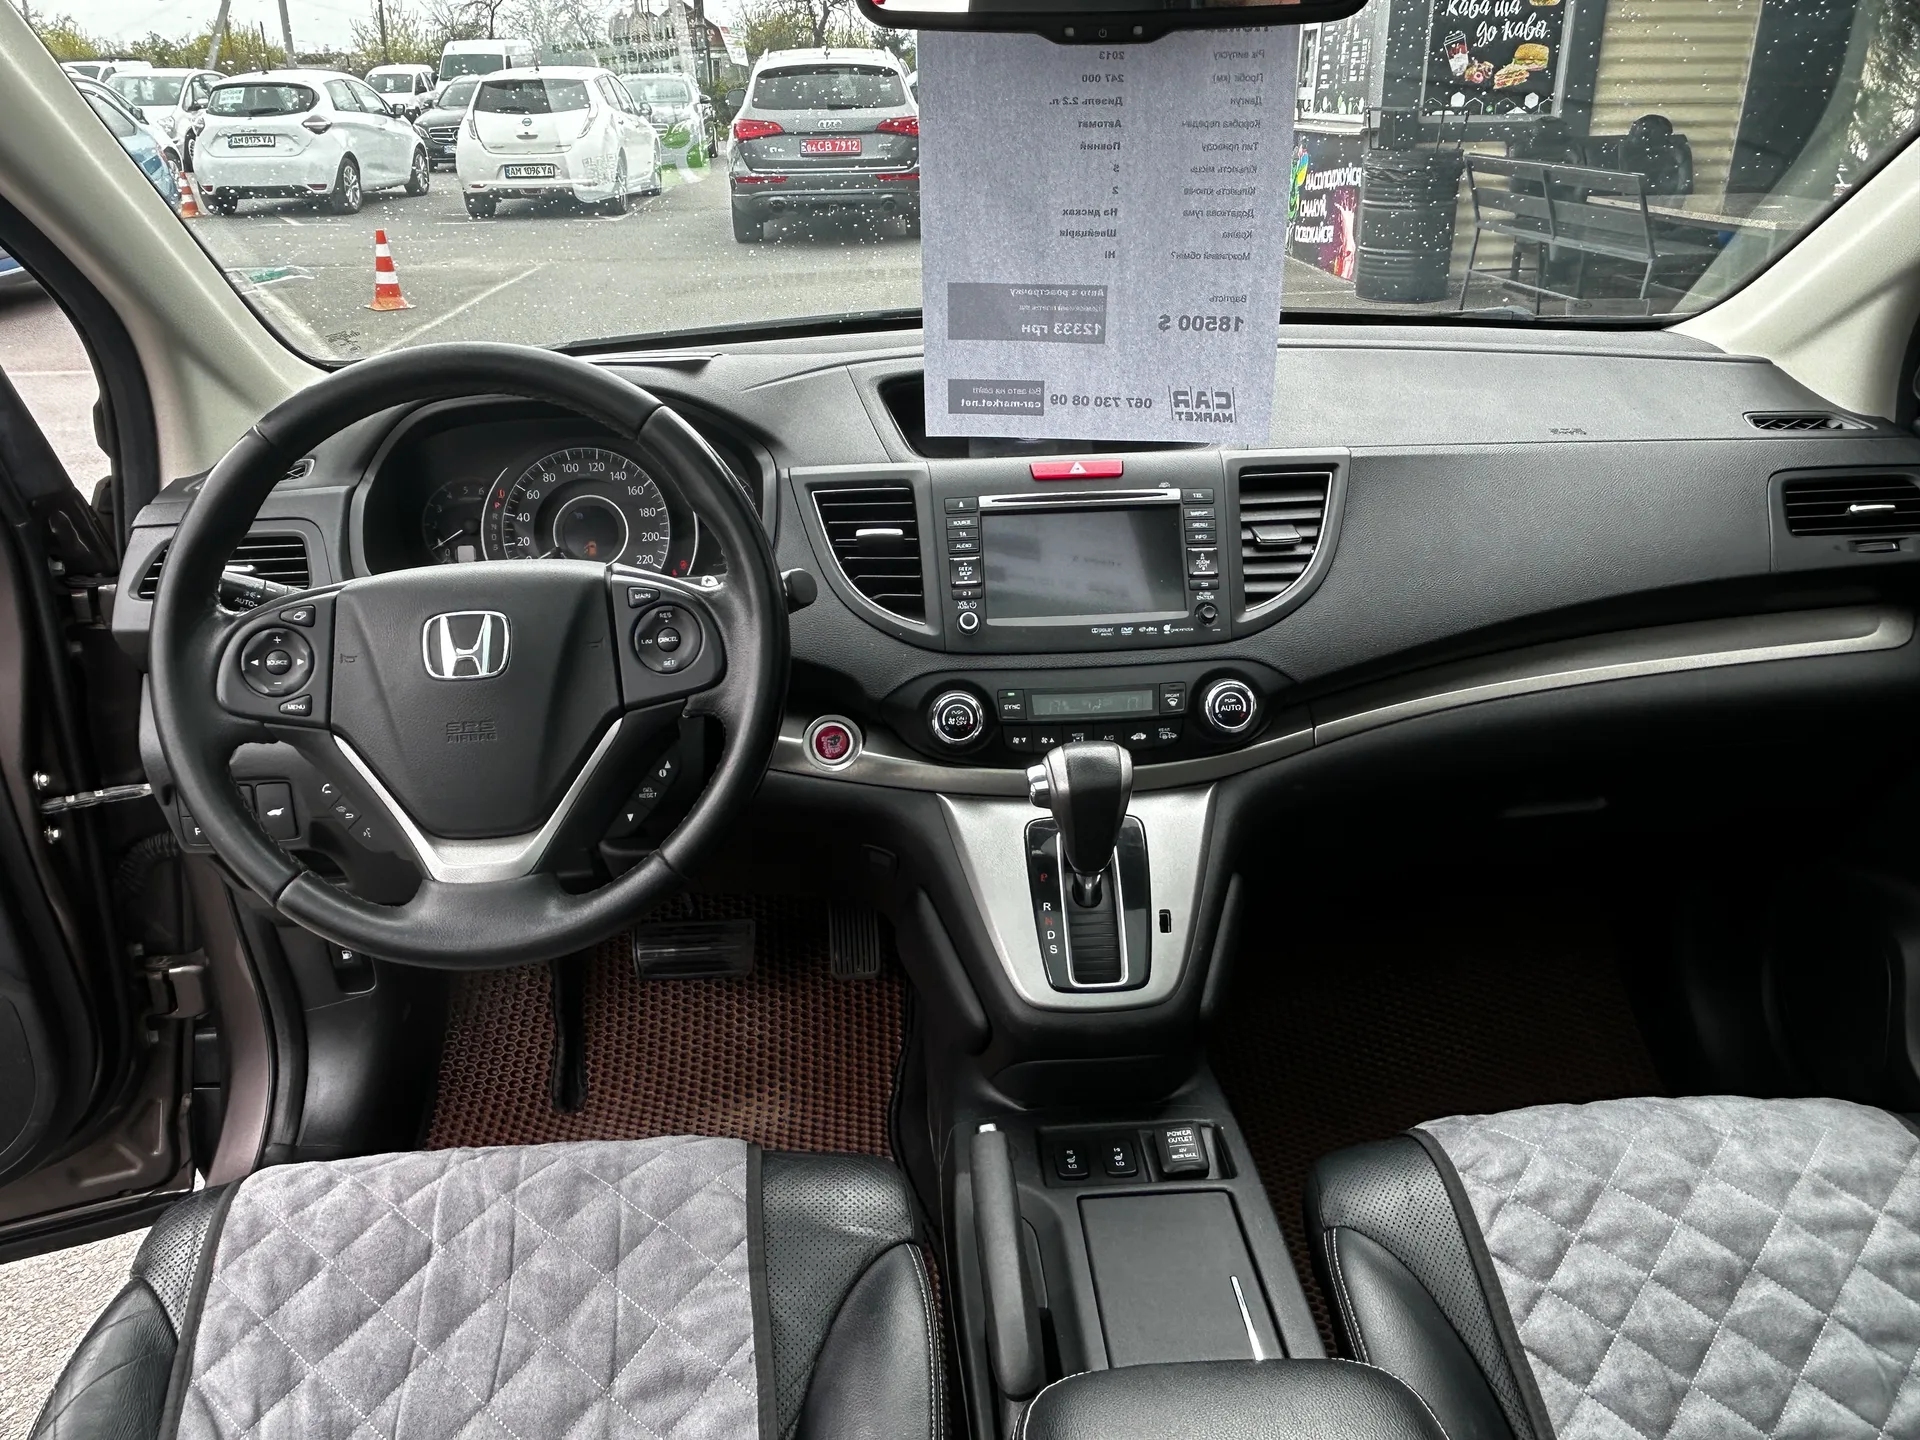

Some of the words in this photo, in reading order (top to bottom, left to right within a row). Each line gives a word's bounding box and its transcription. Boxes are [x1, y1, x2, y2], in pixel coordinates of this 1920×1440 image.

[818, 141, 832, 151] CB
[835, 140, 858, 151] 7912
[562, 463, 579, 473] 100
[588, 462, 605, 472] 120
[542, 472, 556, 482] 80
[610, 470, 627, 481] 140
[526, 489, 540, 500] 60
[627, 485, 644, 496] 160
[516, 512, 530, 523] 40
[639, 507, 656, 518] 180
[517, 536, 530, 546] 20
[642, 531, 659, 542] 200
[636, 555, 654, 566] 220
[234, 597, 255, 607] AUTO
[266, 658, 288, 667] SOURCE
[287, 702, 306, 710] MENU
[1221, 704, 1242, 712] AUTO
[1043, 902, 1051, 911] R
[1048, 930, 1056, 939] D
[1050, 945, 1057, 954] S
